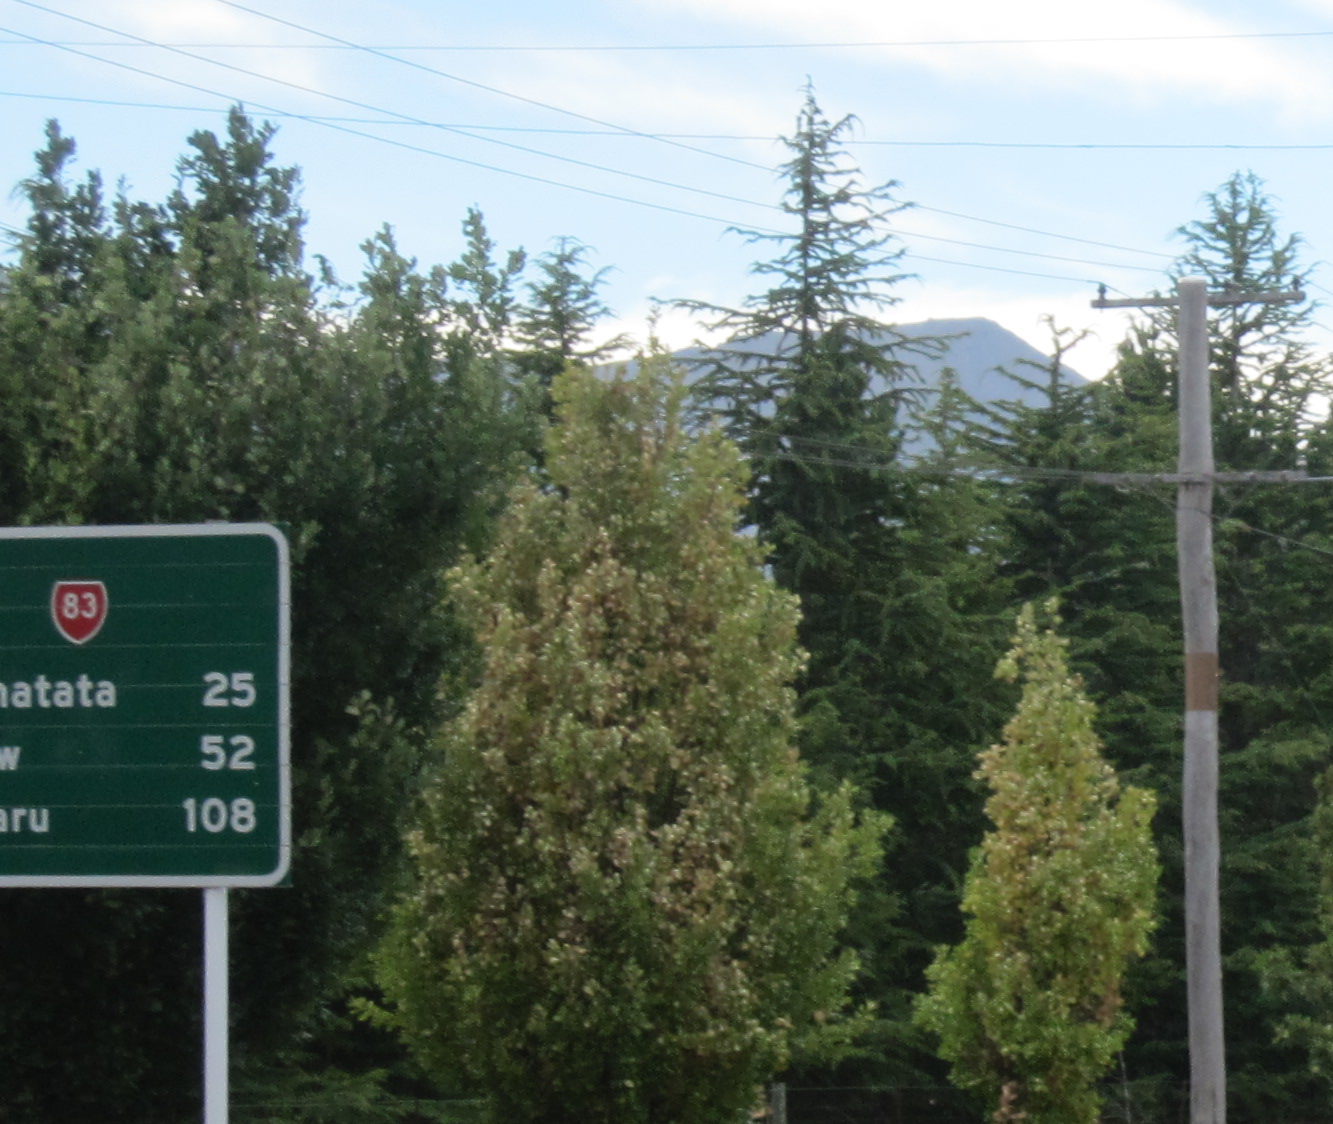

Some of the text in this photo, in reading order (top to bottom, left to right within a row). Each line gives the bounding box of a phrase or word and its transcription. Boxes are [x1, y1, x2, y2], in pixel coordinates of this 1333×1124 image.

[63, 592, 97, 619] 83
[0, 671, 257, 708] atata 25
[201, 735, 257, 771] 52
[182, 797, 257, 834] 108
